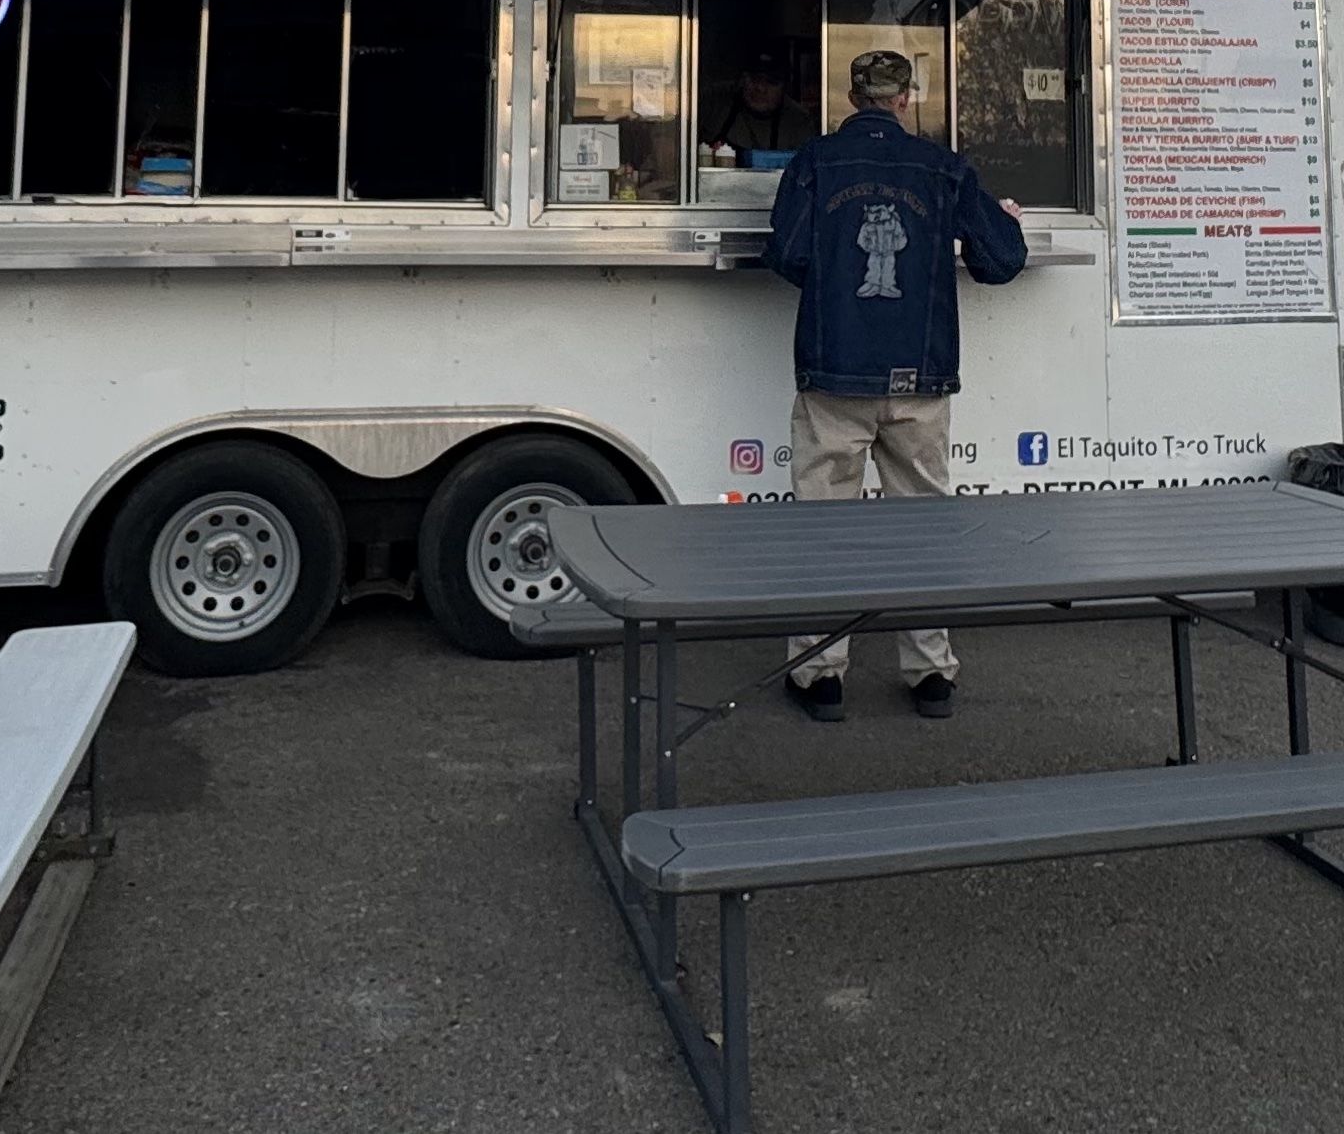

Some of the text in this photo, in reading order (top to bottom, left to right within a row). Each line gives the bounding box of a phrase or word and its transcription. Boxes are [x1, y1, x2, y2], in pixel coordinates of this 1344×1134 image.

[1119, 16, 1311, 30] TACOS (FLOUR) $4
[1119, 36, 1153, 46] TACOS
[1155, 36, 1189, 46] ESTILO
[1190, 37, 1258, 47] GUADALAJARA
[1119, 56, 1313, 69] QUESADILLA $4
[1120, 76, 1183, 86] QUESADILLA
[1238, 77, 1277, 89] (CRISPY)
[1121, 96, 1317, 107] SUPER BURRITO $10
[1121, 115, 1169, 126] REGULAR
[1171, 116, 1215, 126] BURRITO
[1122, 135, 1144, 144] MAR
[1145, 135, 1153, 144] Y
[1154, 135, 1191, 144] TIERRA
[1192, 135, 1235, 145] BURRITO
[1124, 155, 1163, 165] TORTAS
[1125, 174, 1176, 185] TOSTADAS
[1125, 196, 1177, 206] TOSTADAS
[1179, 196, 1194, 206] DE
[1195, 196, 1237, 206] CEVICHE
[1126, 209, 1178, 219] TOSTADAS
[1180, 209, 1194, 219] DE
[1195, 209, 1244, 219] CAMARON
[1204, 223, 1253, 238] MEATS
[1058, 436, 1074, 459] El
[1078, 436, 1158, 463] Taquito
[1213, 431, 1267, 456] Truck
